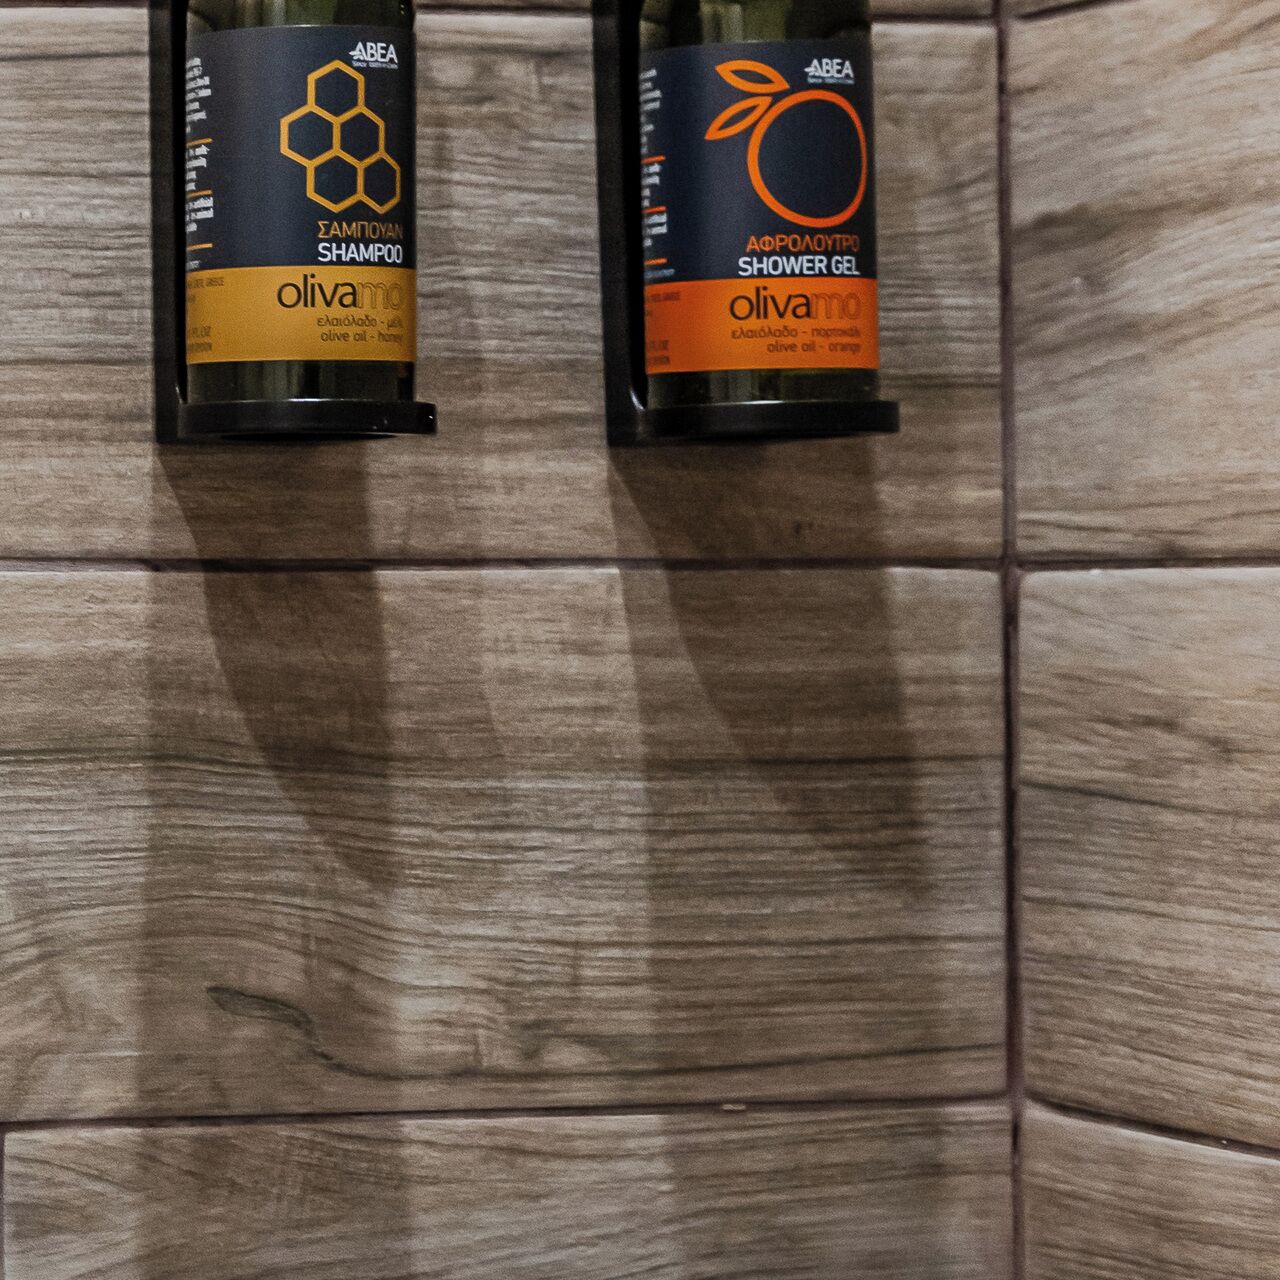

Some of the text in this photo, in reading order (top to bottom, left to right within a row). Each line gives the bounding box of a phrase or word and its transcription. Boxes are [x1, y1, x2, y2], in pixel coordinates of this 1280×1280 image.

[350, 41, 398, 63] ABEA
[805, 58, 854, 78] ABEA
[318, 242, 403, 263] SHAMPOO
[738, 256, 860, 276] SHOWER GEL
[321, 329, 351, 342] olive
